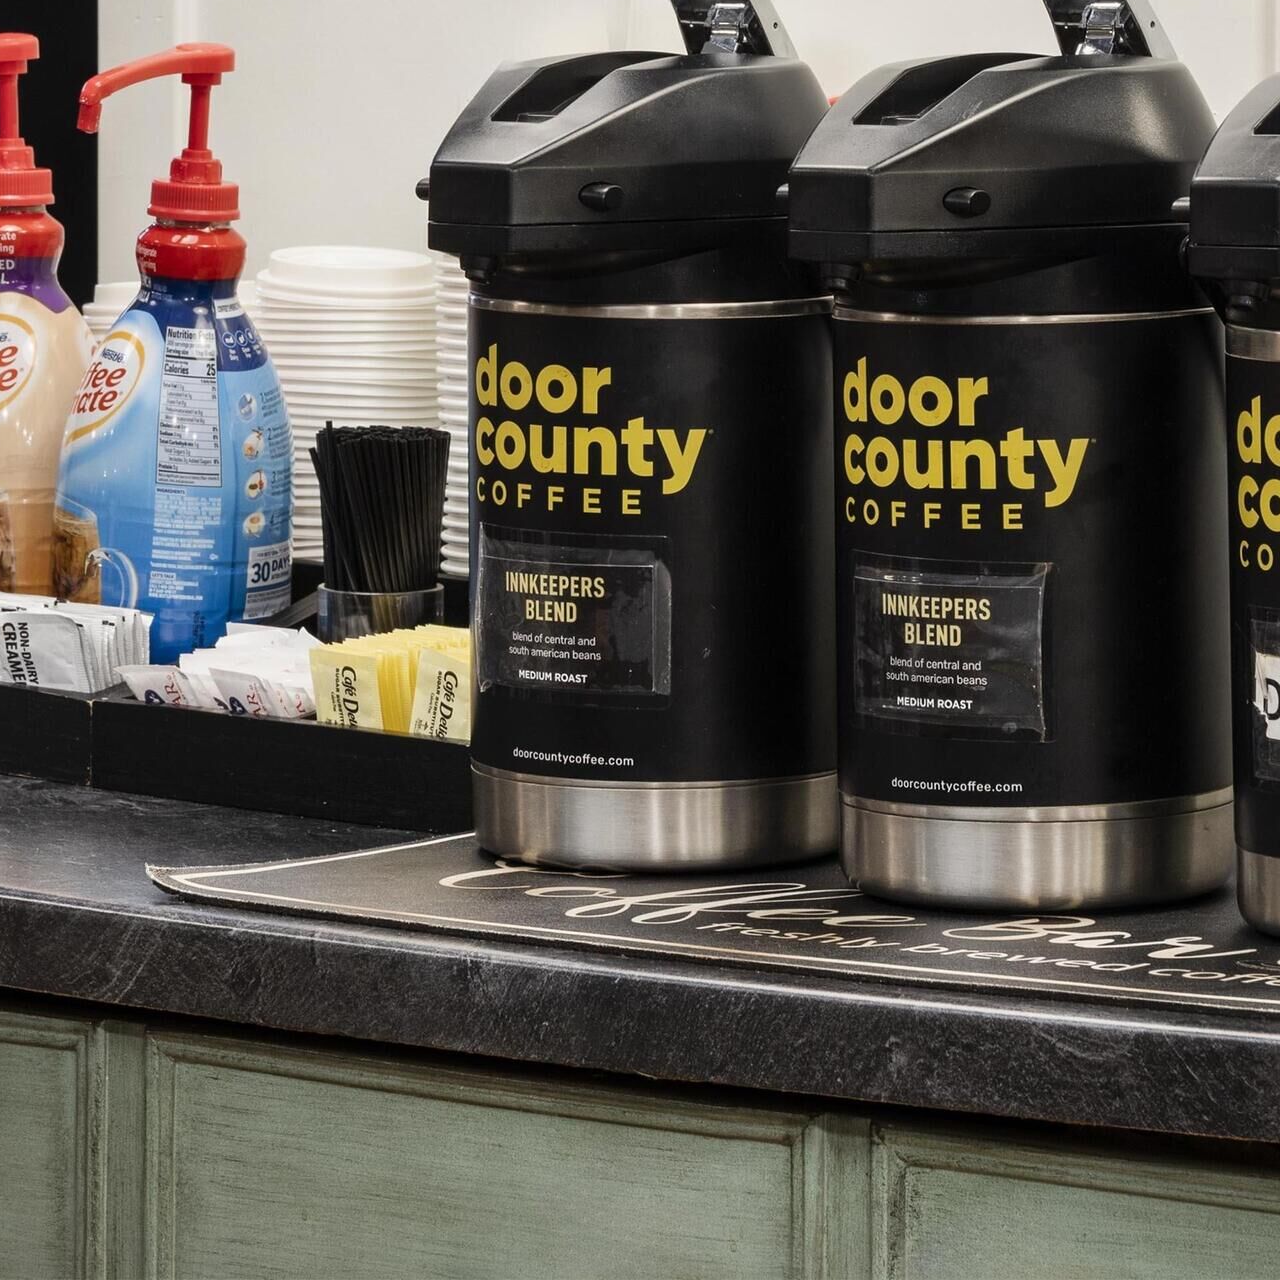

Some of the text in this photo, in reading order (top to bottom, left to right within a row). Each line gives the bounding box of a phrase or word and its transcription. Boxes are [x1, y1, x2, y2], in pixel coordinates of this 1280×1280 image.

[167, 328, 197, 340] Nutrition
[164, 363, 217, 377] Calories 25
[476, 343, 612, 415] door
[843, 356, 988, 426] door
[476, 417, 707, 495] county
[844, 427, 1089, 508] county
[477, 476, 641, 515] COFFEE
[845, 496, 1023, 530] COFFEE
[251, 561, 270, 584] 30
[505, 571, 605, 598] INNKEEPERS
[525, 599, 577, 623] BLEND
[882, 593, 991, 621] INNKEEPERS
[512, 631, 596, 647] blend of central and
[904, 623, 962, 647] BLEND
[17, 622, 39, 685] NON-DAIRY
[508, 645, 602, 661] south american beans
[890, 656, 982, 671] blend of central and
[342, 666, 357, 697] Café
[443, 671, 458, 702] Café
[518, 669, 588, 684] MEDIUM ROAST
[886, 671, 988, 686] south american beans
[896, 696, 974, 710] MEDIUM ROAST
[513, 747, 634, 766] doorcountycoffee.com
[891, 777, 1023, 794] doorcountycoffee.com
[696, 921, 901, 948] freshly
[901, 942, 1150, 973] brewed
